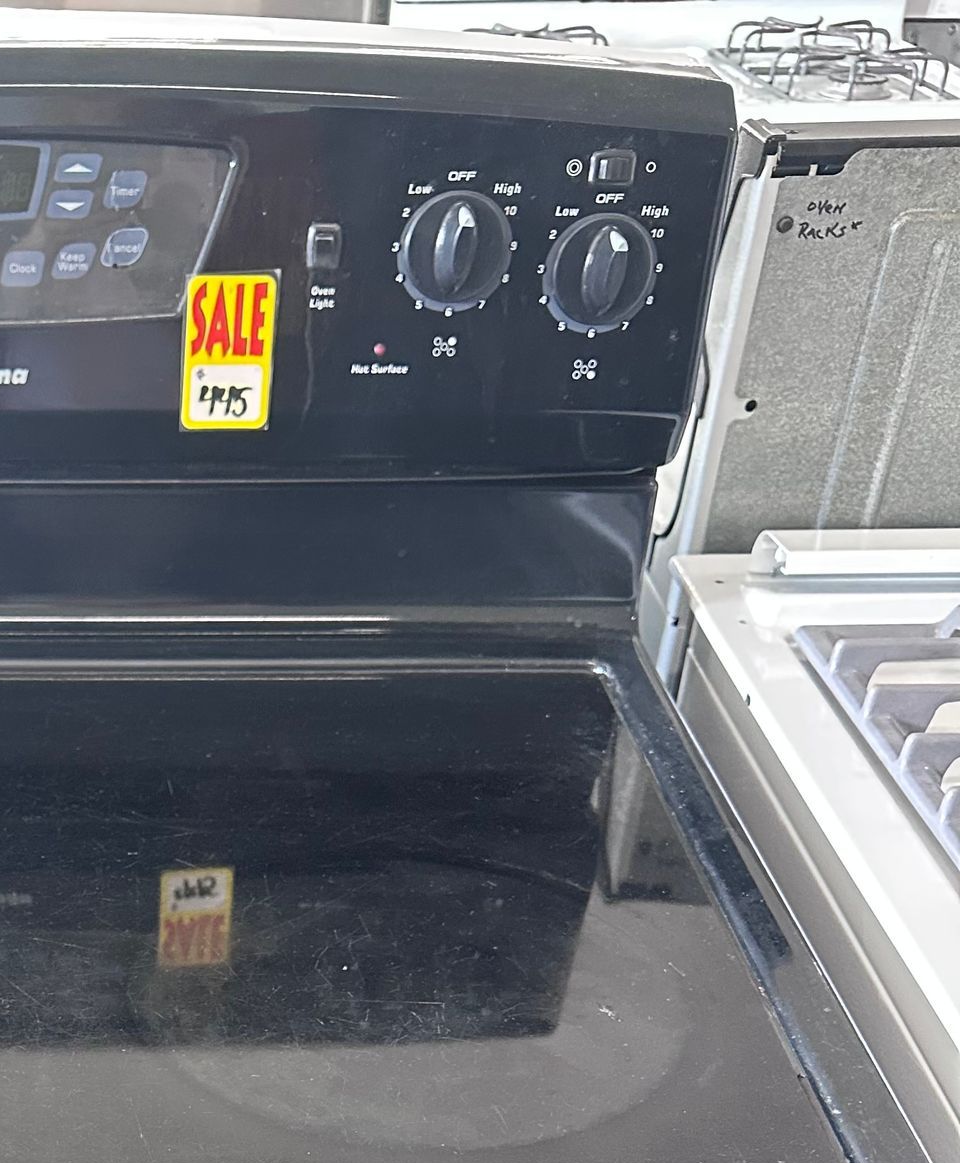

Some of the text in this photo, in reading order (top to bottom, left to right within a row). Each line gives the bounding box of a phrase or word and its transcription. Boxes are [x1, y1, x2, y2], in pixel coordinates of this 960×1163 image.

[448, 171, 477, 181] OFF
[111, 186, 140, 196] Timer
[408, 184, 432, 194] Low
[493, 183, 522, 196] High
[595, 193, 625, 204] OFF
[402, 208, 411, 217] 2
[504, 206, 518, 215] 10
[555, 206, 580, 217] Low
[641, 205, 669, 218] High
[548, 229, 558, 240] 2
[650, 228, 664, 239] 10
[391, 242, 400, 252] 3
[510, 241, 518, 251] 9
[59, 252, 85, 264] Keep
[9, 263, 37, 274] Clock
[57, 262, 88, 272] Warm
[537, 265, 545, 274] 3
[655, 263, 664, 273] 9
[395, 273, 403, 283] 4
[501, 274, 509, 283] 8
[310, 285, 336, 296] Oven
[309, 298, 335, 310] Light
[415, 300, 423, 310] 5
[478, 300, 486, 309] 7
[538, 295, 548, 305] 4
[646, 295, 654, 305] 8
[444, 308, 453, 317] 6
[191, 281, 269, 358] SALE
[557, 321, 566, 331] 5
[621, 321, 629, 331] 7
[587, 328, 596, 338] 6
[371, 363, 409, 374] Surface
